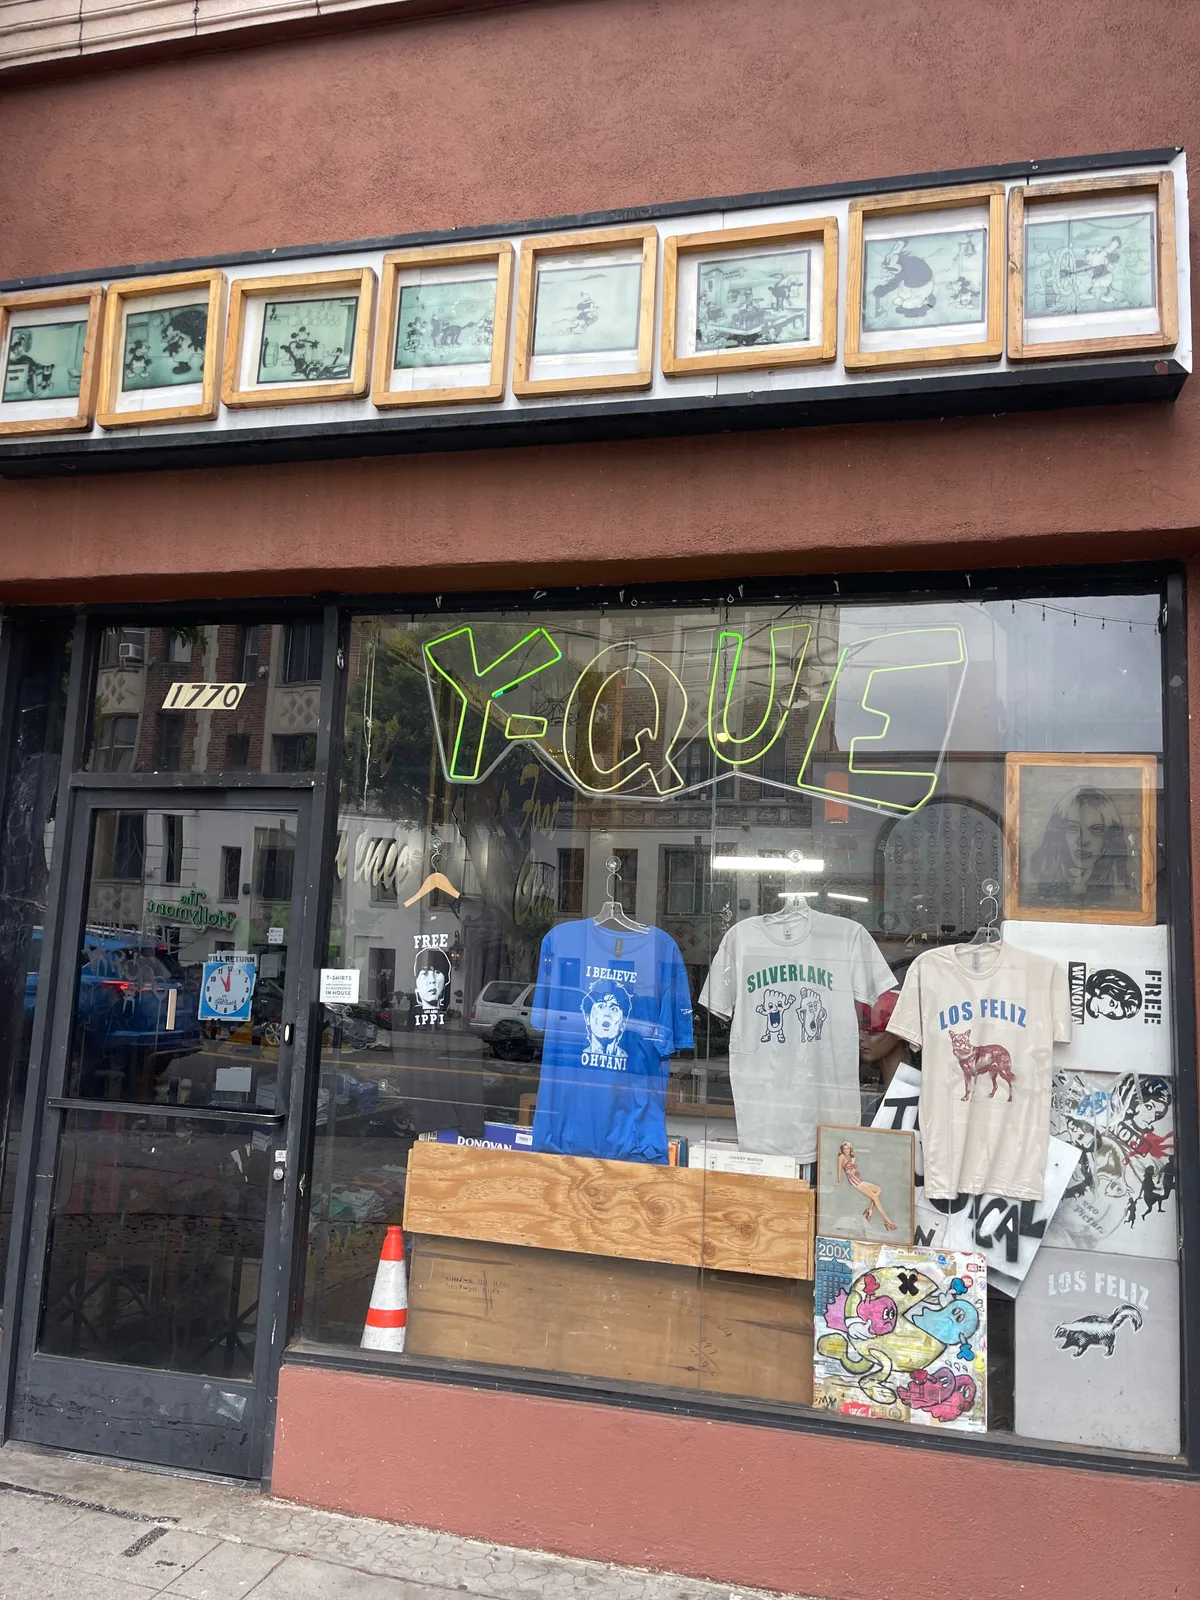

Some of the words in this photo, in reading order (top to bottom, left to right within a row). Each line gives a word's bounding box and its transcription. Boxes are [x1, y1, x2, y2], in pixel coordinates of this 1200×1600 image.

[169, 684, 240, 708] 1770
[424, 624, 964, 811] Y-QUE
[413, 933, 448, 949] FREE
[225, 955, 255, 963] RETURN
[586, 966, 592, 977] I
[593, 966, 638, 983] BELIEVE
[746, 964, 834, 993] SILVERLAKE
[1071, 965, 1085, 1025] WINONA
[1144, 969, 1162, 1025] FREE
[415, 1013, 445, 1026] IPPI
[939, 1001, 973, 1031] LOS
[980, 998, 1027, 1029] FELIZ
[581, 1052, 628, 1071] OHTANI
[818, 1243, 851, 1259] 200X
[1048, 1270, 1087, 1296] LOS
[1094, 1271, 1150, 1311] FELIZ
